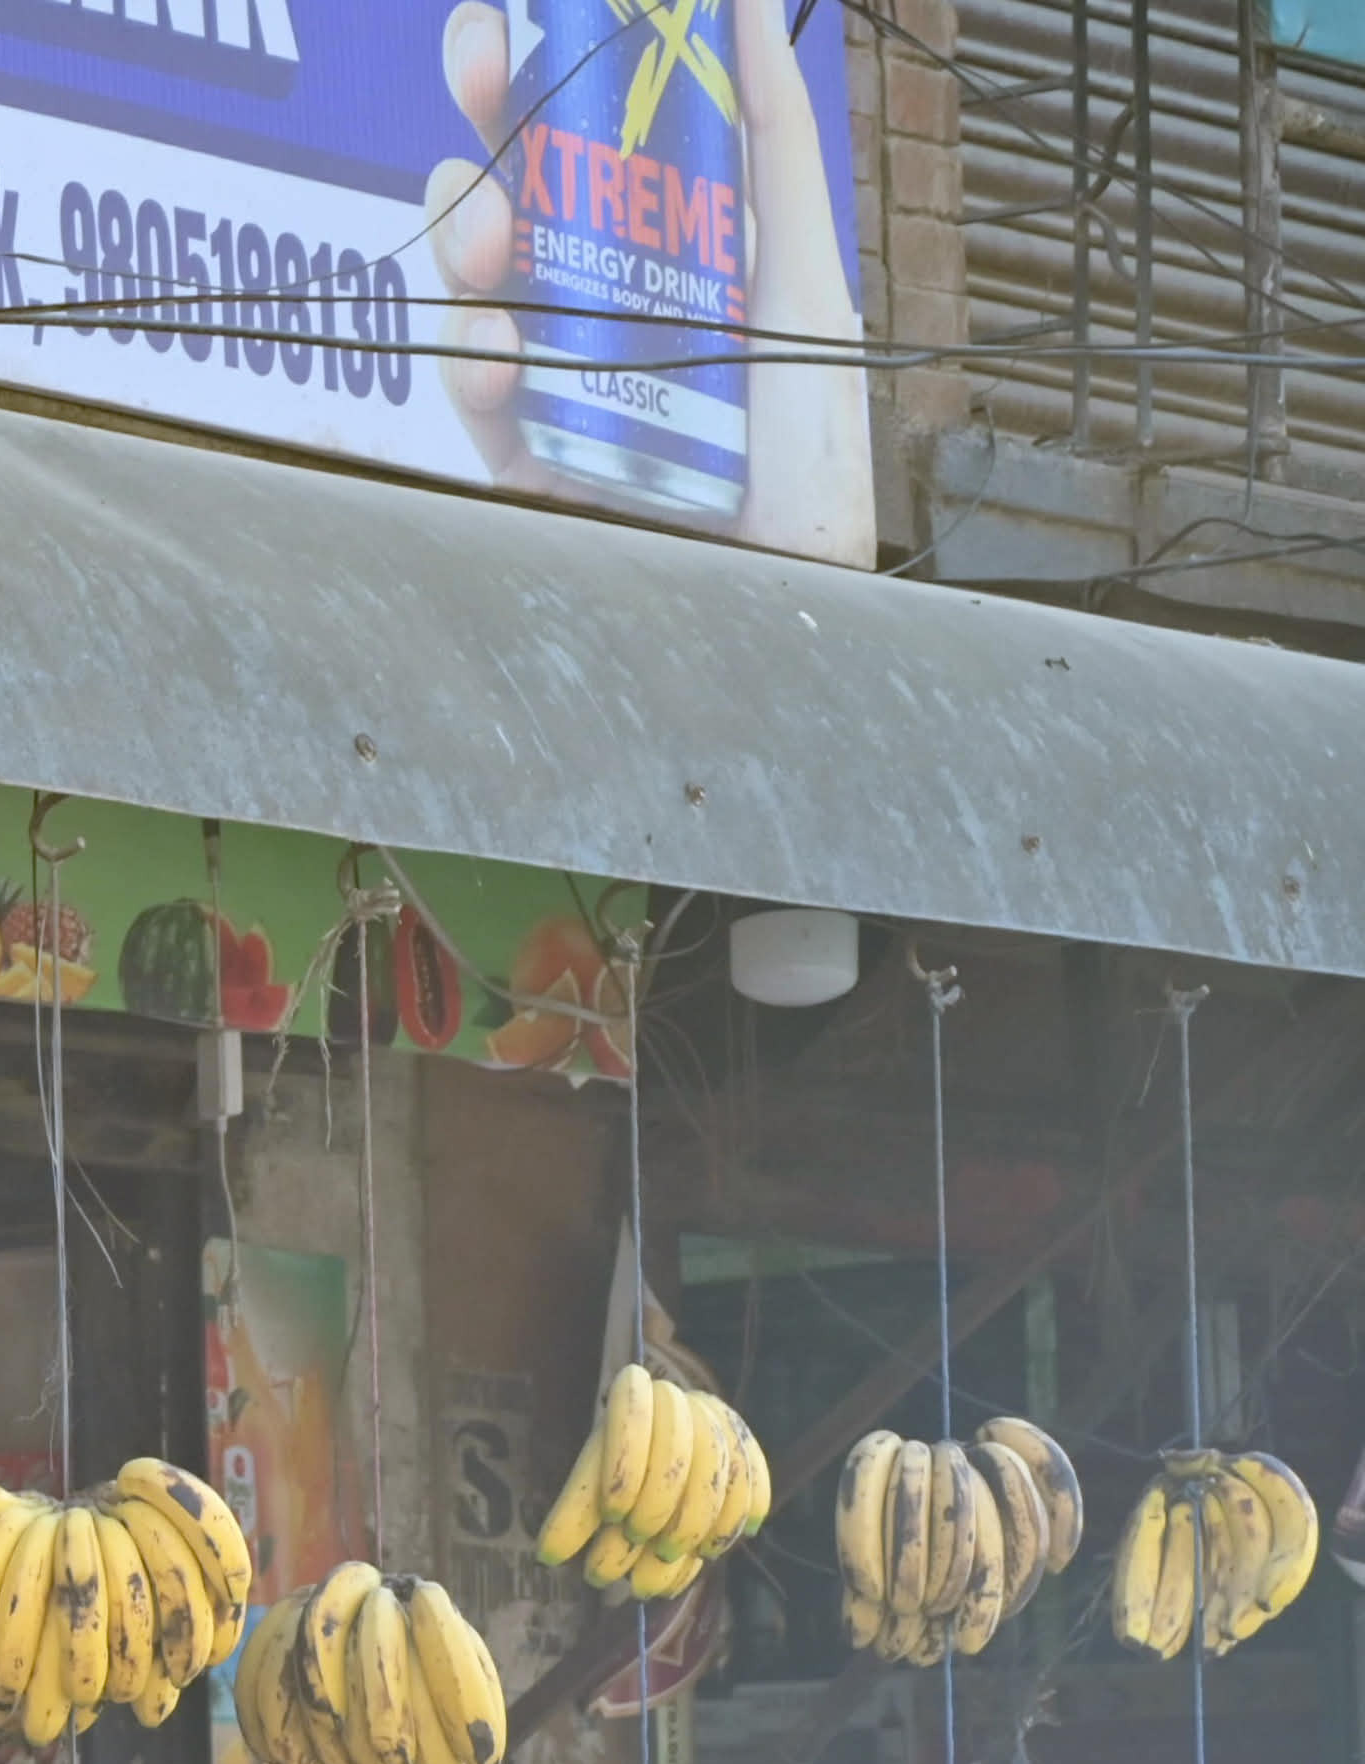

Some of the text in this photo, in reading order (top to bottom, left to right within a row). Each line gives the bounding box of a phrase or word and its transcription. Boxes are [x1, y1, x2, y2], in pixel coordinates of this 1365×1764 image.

[520, 122, 737, 275] XTREME
[532, 225, 723, 315] ENERGY DRINK
[534, 262, 609, 301] ENERGIZES
[612, 286, 651, 315] BODY
[581, 370, 671, 418] CLASSIC
